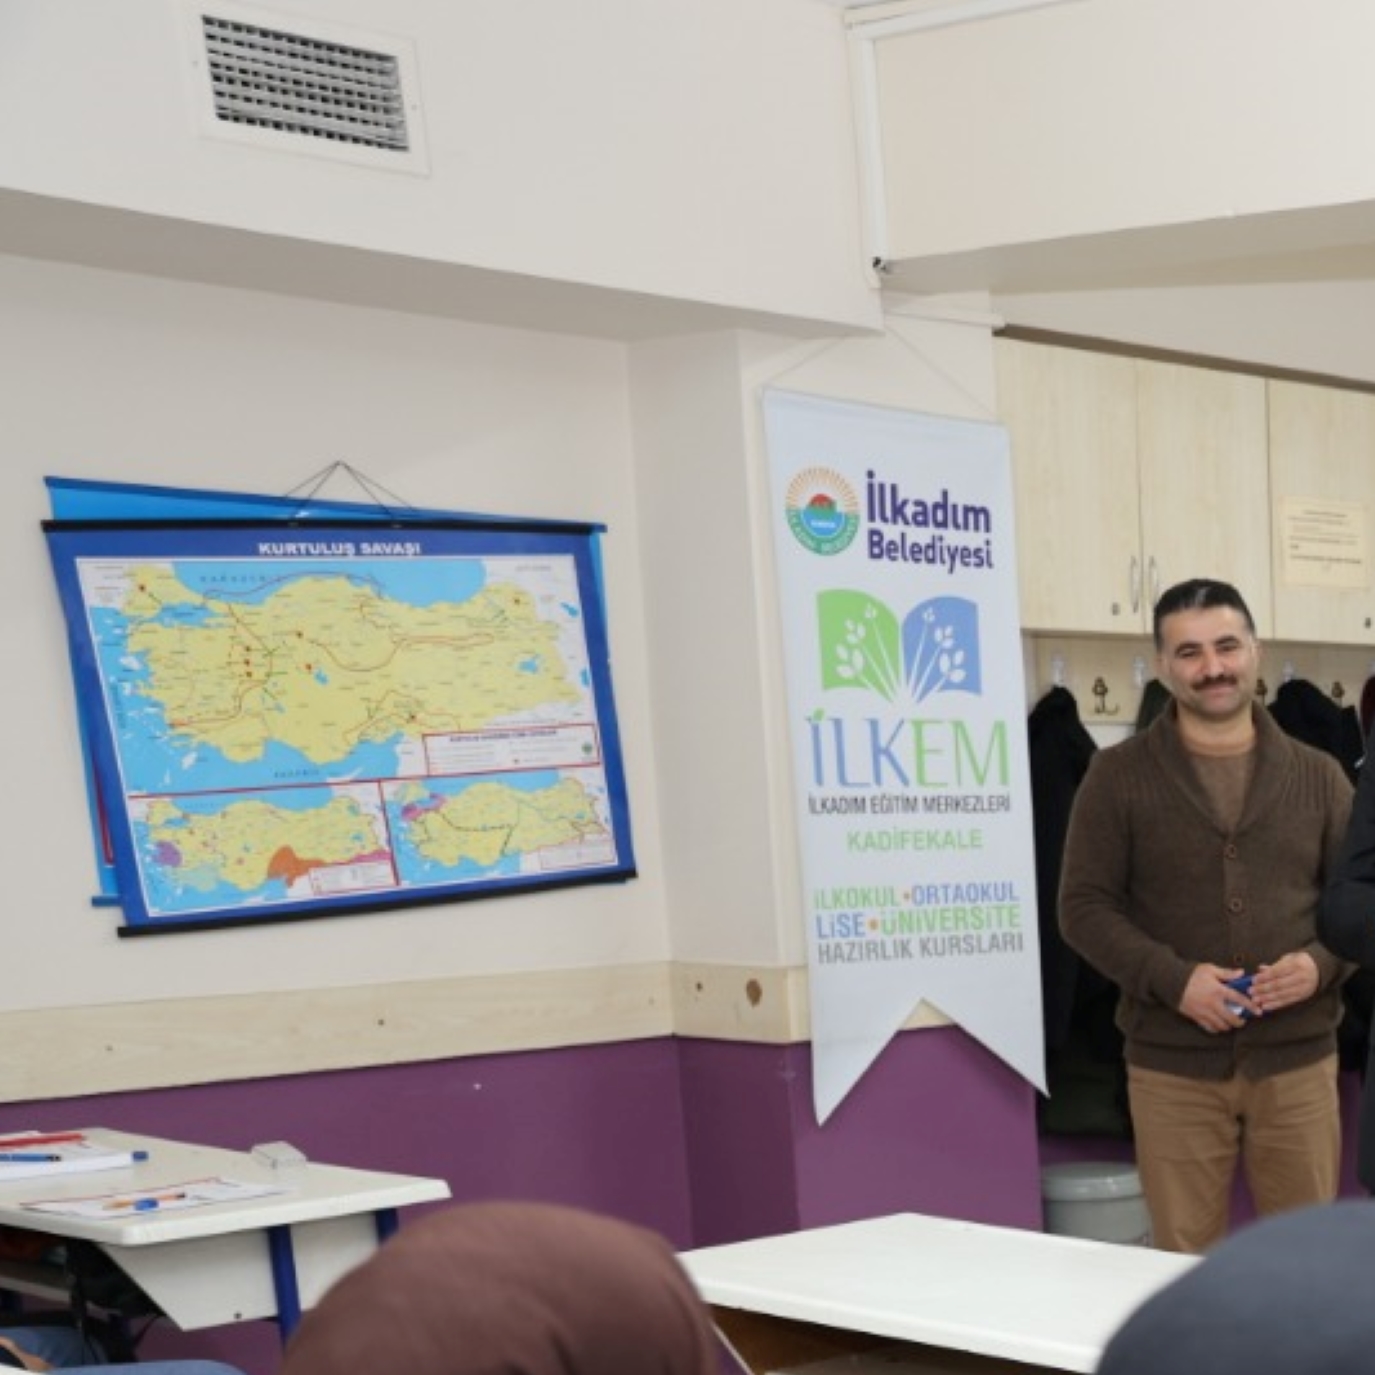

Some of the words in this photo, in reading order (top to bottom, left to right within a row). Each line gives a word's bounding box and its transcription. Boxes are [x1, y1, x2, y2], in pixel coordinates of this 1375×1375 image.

[866, 469, 991, 533] İlkadım
[258, 542, 356, 556] KURTULUŞ
[359, 542, 421, 557] SAVAŞI
[867, 528, 993, 574] Belediyesi
[805, 707, 1009, 788] İLKEM
[808, 793, 866, 814] İLKADIM
[871, 793, 917, 814] EĞİTİM
[922, 793, 1010, 814] MERKEZLERİ
[847, 826, 983, 851] KADİFEKALE
[912, 881, 1020, 906] ORTAOKUL
[818, 938, 913, 964] HAZIRLIK
[919, 933, 1023, 958] KURSLARI
